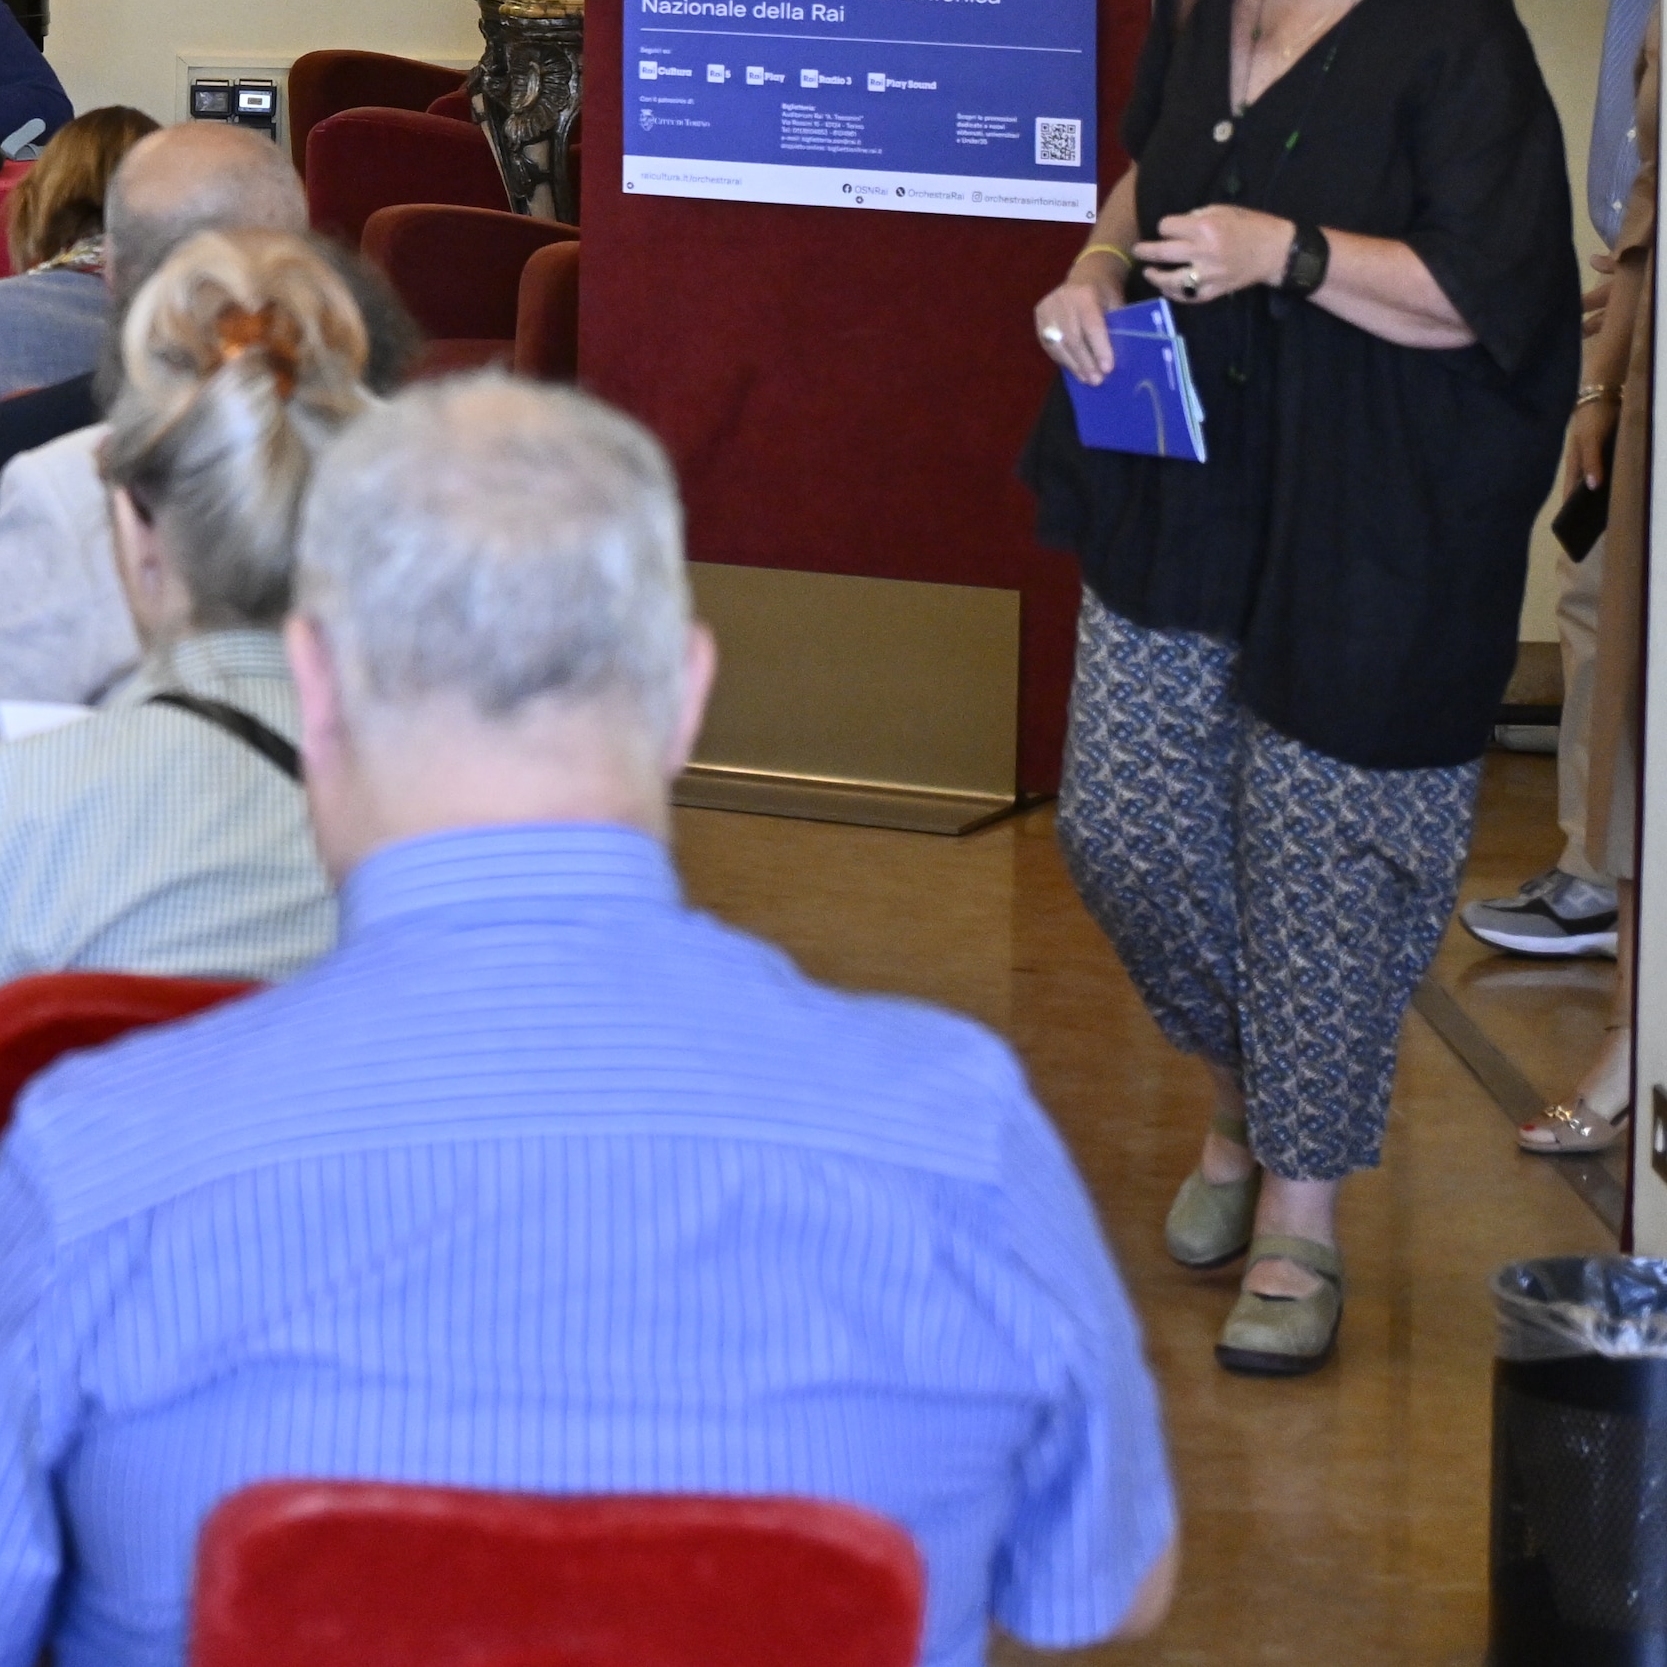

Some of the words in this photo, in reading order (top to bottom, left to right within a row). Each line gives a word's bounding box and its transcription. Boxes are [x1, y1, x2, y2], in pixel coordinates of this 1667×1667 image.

[752, 1, 805, 21] della
[811, 4, 845, 23] Rai
[854, 185, 889, 197] OSNRai
[908, 188, 965, 201] OrchestraRai
